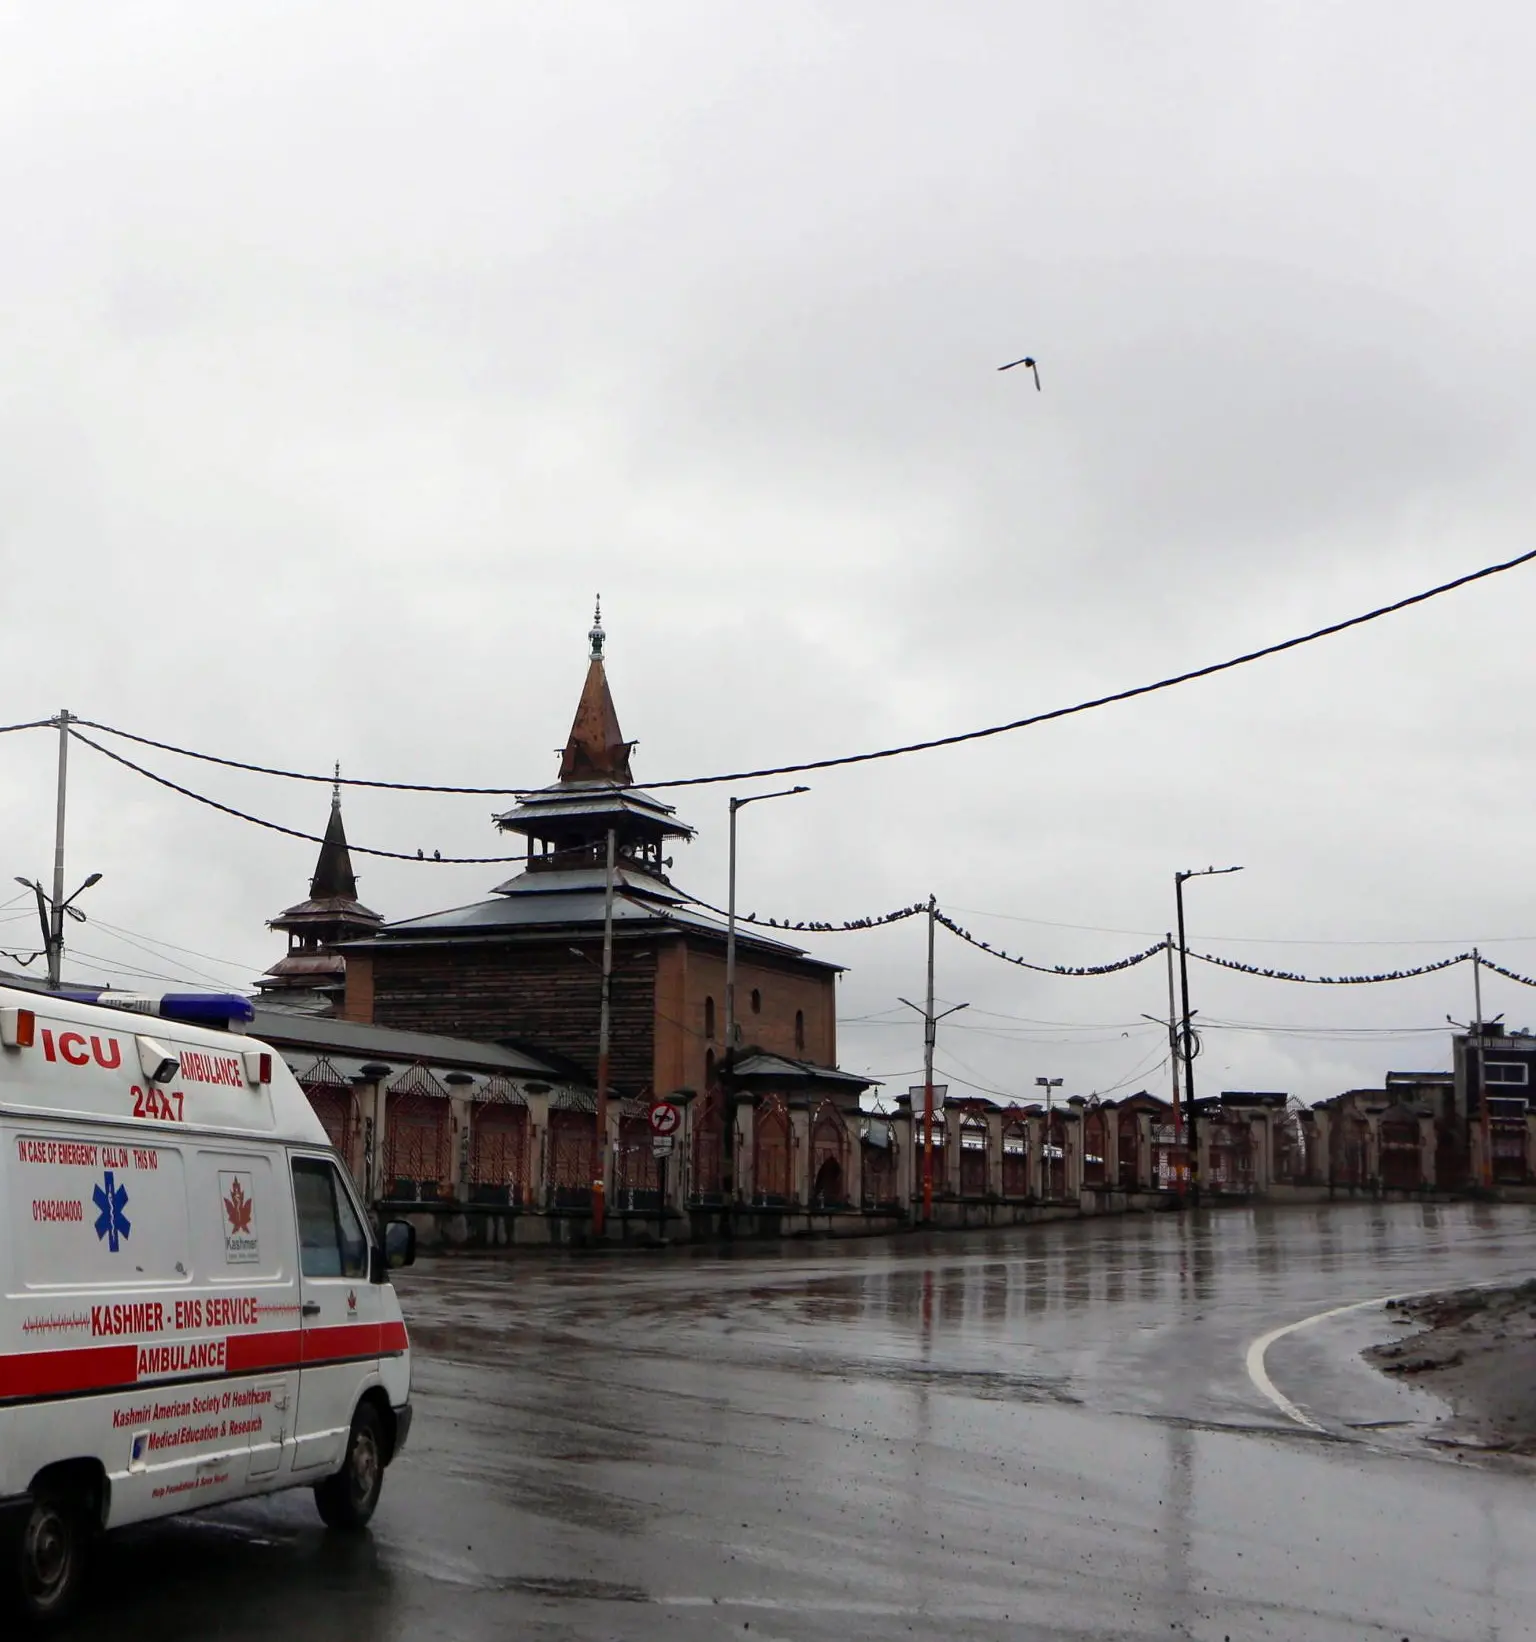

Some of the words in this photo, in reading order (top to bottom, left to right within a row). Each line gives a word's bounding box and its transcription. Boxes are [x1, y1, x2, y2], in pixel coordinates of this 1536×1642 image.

[41, 1029, 121, 1069] ICU
[179, 1051, 243, 1087] AMBULANCE
[18, 1141, 27, 1162] IN
[28, 1141, 46, 1163] CASE
[48, 1142, 57, 1164] OF
[59, 1143, 98, 1166] EMERGENCY
[102, 1147, 118, 1168] CALL
[119, 1148, 128, 1168] ON
[133, 1150, 148, 1170] THIS
[149, 1150, 158, 1170] NO
[32, 1199, 82, 1222] 01942404000
[226, 1236, 258, 1250] Kashmer
[91, 1302, 164, 1336] KASHMER
[175, 1300, 202, 1329] EMS
[205, 1297, 258, 1327] SERVICE
[138, 1342, 225, 1374] AMBULANCE
[112, 1404, 152, 1428] Kashmiri
[152, 1402, 191, 1421] American
[192, 1395, 221, 1414] Society
[222, 1391, 230, 1409] Of
[232, 1388, 272, 1408] Healthcare
[148, 1430, 180, 1450] Medical
[179, 1425, 220, 1444] Education
[221, 1421, 227, 1437] &
[229, 1416, 262, 1436] Research
